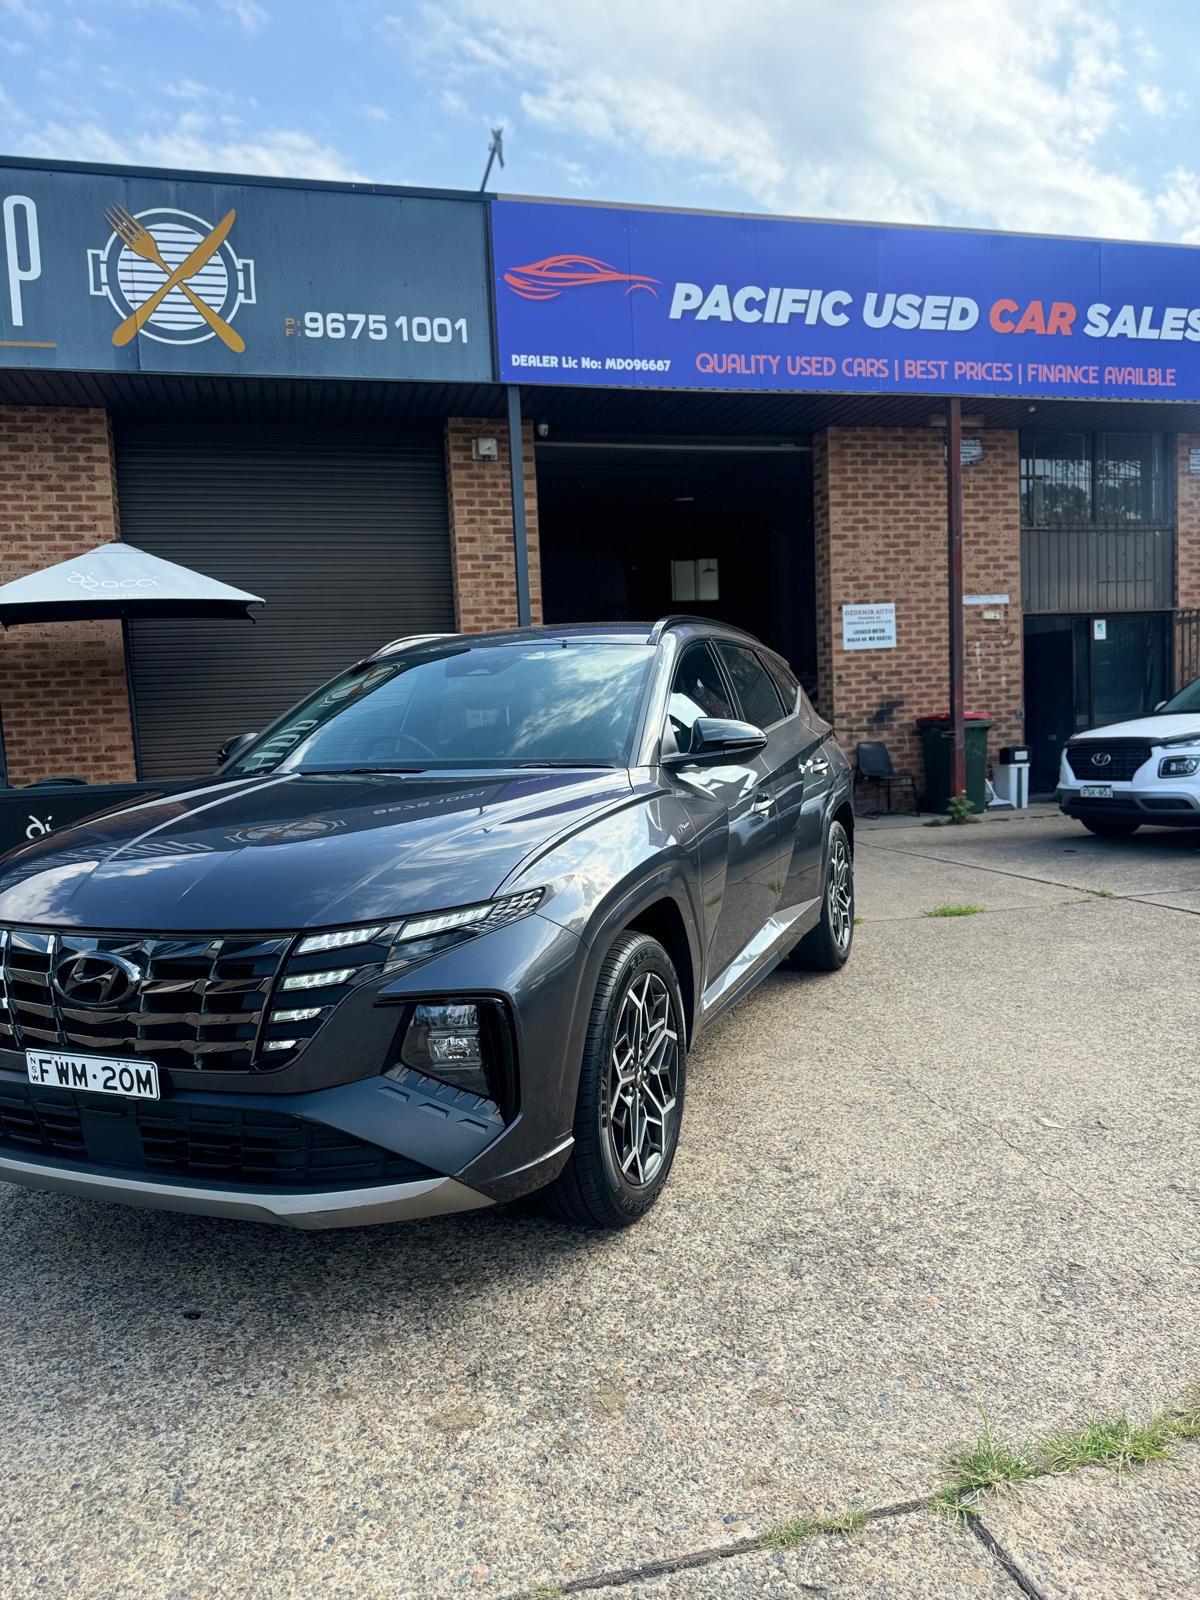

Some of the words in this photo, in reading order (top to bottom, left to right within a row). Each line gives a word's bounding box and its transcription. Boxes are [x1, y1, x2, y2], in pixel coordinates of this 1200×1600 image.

[303, 311, 388, 341] 9675
[395, 315, 468, 344] 1001
[668, 282, 853, 328] PACIFIC
[862, 291, 980, 332] USED
[988, 298, 1077, 336] CAR
[1083, 303, 1200, 343] SALES
[511, 354, 559, 368] DEALER
[562, 356, 578, 369] Lic
[581, 357, 602, 370] No:
[695, 352, 782, 376] QUALITY
[787, 355, 837, 377] USED
[841, 357, 889, 379] CARS
[904, 359, 949, 380] BEST
[954, 361, 1014, 383] PRICES
[1027, 363, 1100, 385] FINANCE
[1104, 366, 1177, 387] AVAILBLE
